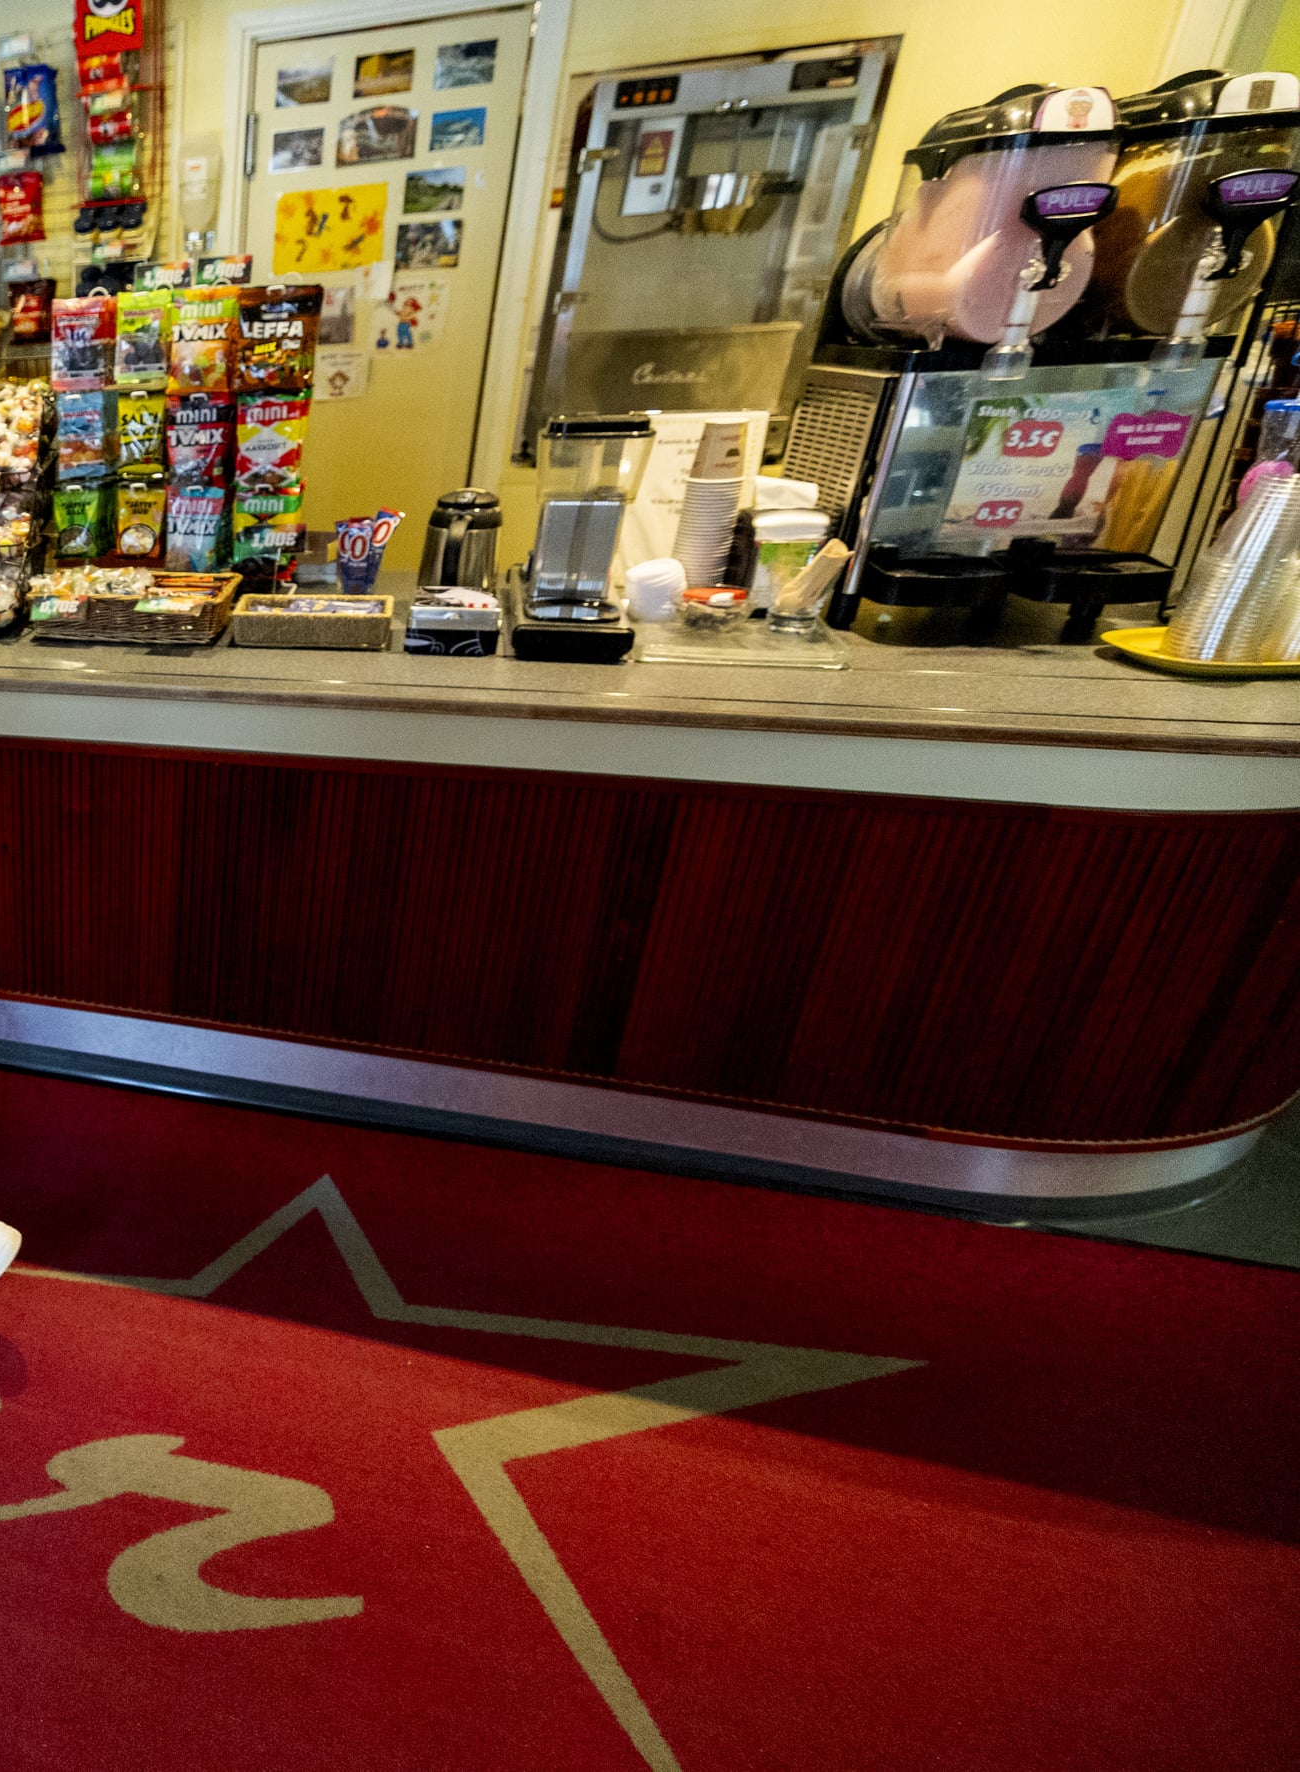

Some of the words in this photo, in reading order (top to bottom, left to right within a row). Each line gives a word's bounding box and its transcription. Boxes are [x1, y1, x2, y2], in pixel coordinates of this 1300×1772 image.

[1230, 178, 1280, 196] PULL
[1046, 193, 1097, 210] PULL
[180, 302, 223, 318] mini
[241, 320, 304, 340] LEFFA
[175, 407, 218, 424] mini
[245, 404, 288, 423] mini
[1006, 429, 1060, 449] 3,5€
[243, 496, 285, 513] mini
[976, 507, 1020, 522] 8,5€
[251, 531, 296, 547] 1,00€
